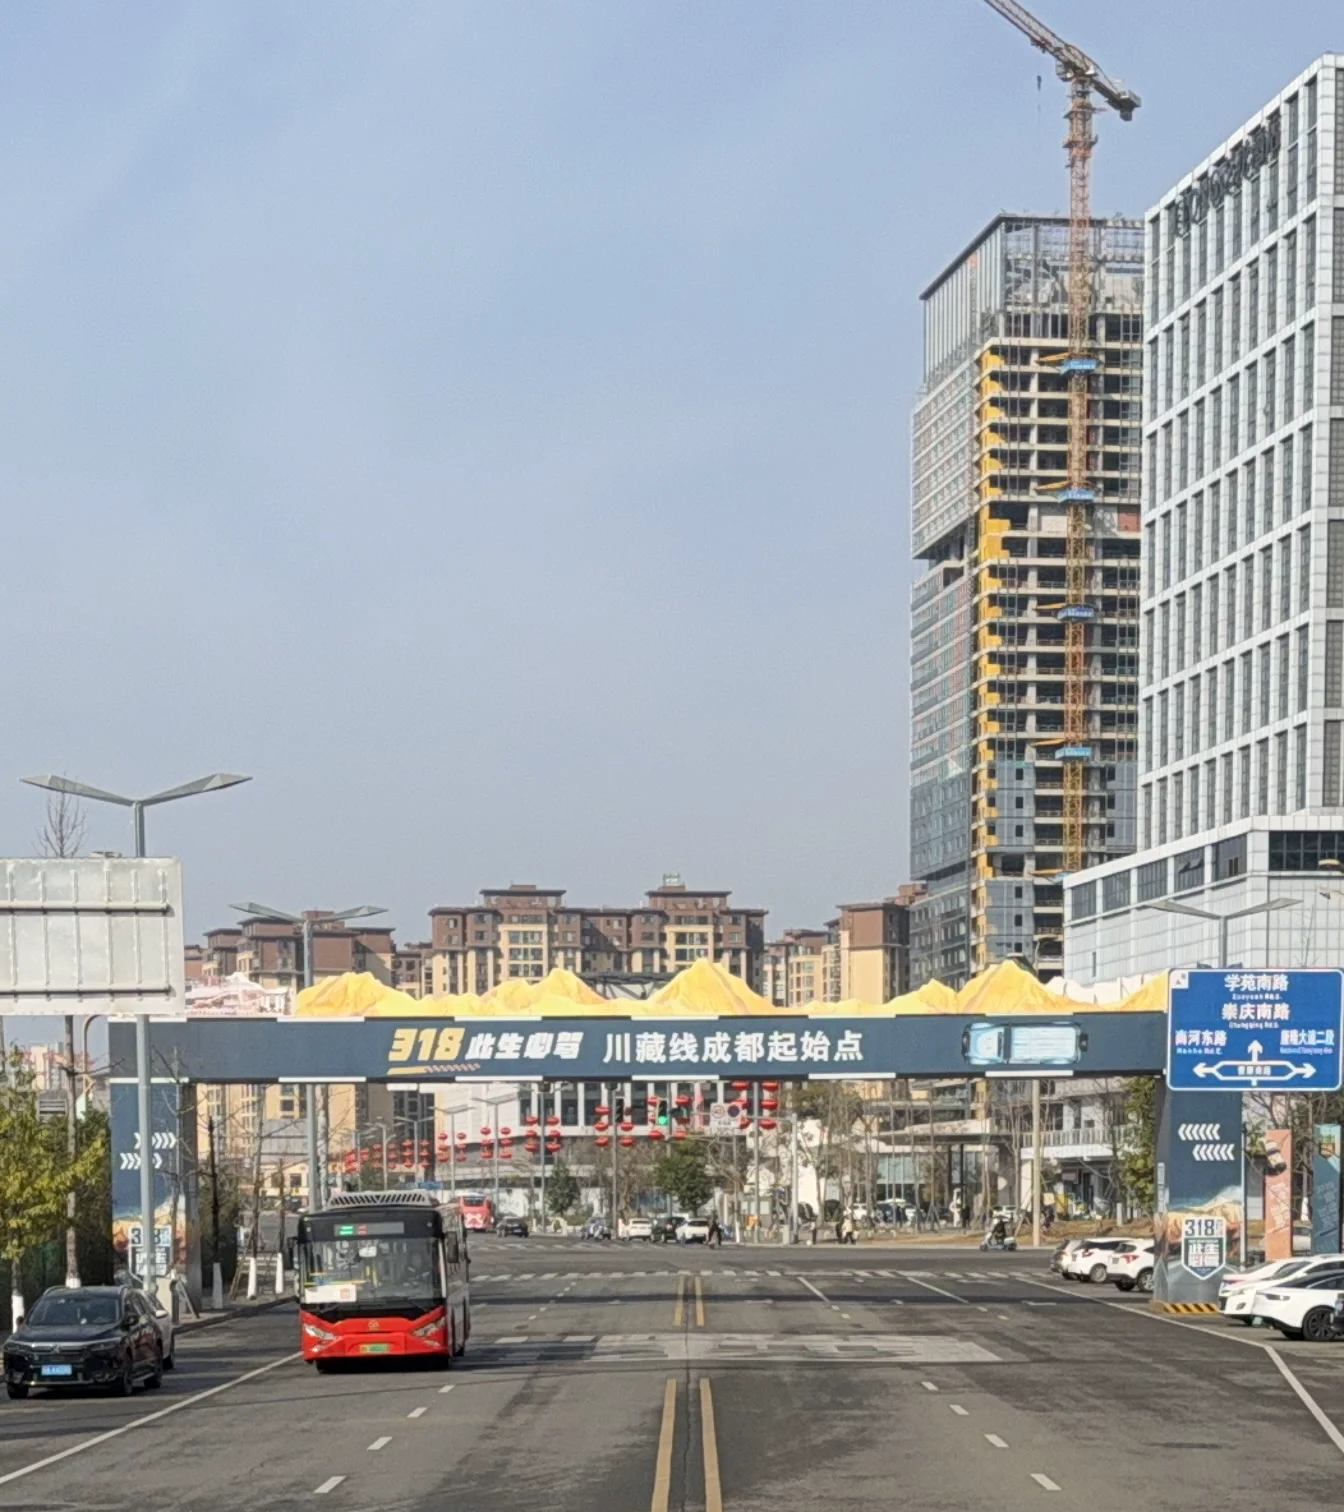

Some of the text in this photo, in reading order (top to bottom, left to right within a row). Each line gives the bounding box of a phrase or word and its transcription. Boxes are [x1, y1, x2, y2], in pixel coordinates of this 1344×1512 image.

[1224, 974, 1289, 992] 学苑南路
[1222, 1003, 1290, 1020] 崇庆南路
[388, 1027, 864, 1064] 318 此生必驾 川藏线成都起始点
[1175, 1029, 1227, 1047] 南河东路
[1185, 1219, 1215, 1236] 318
[131, 1228, 161, 1245] 38
